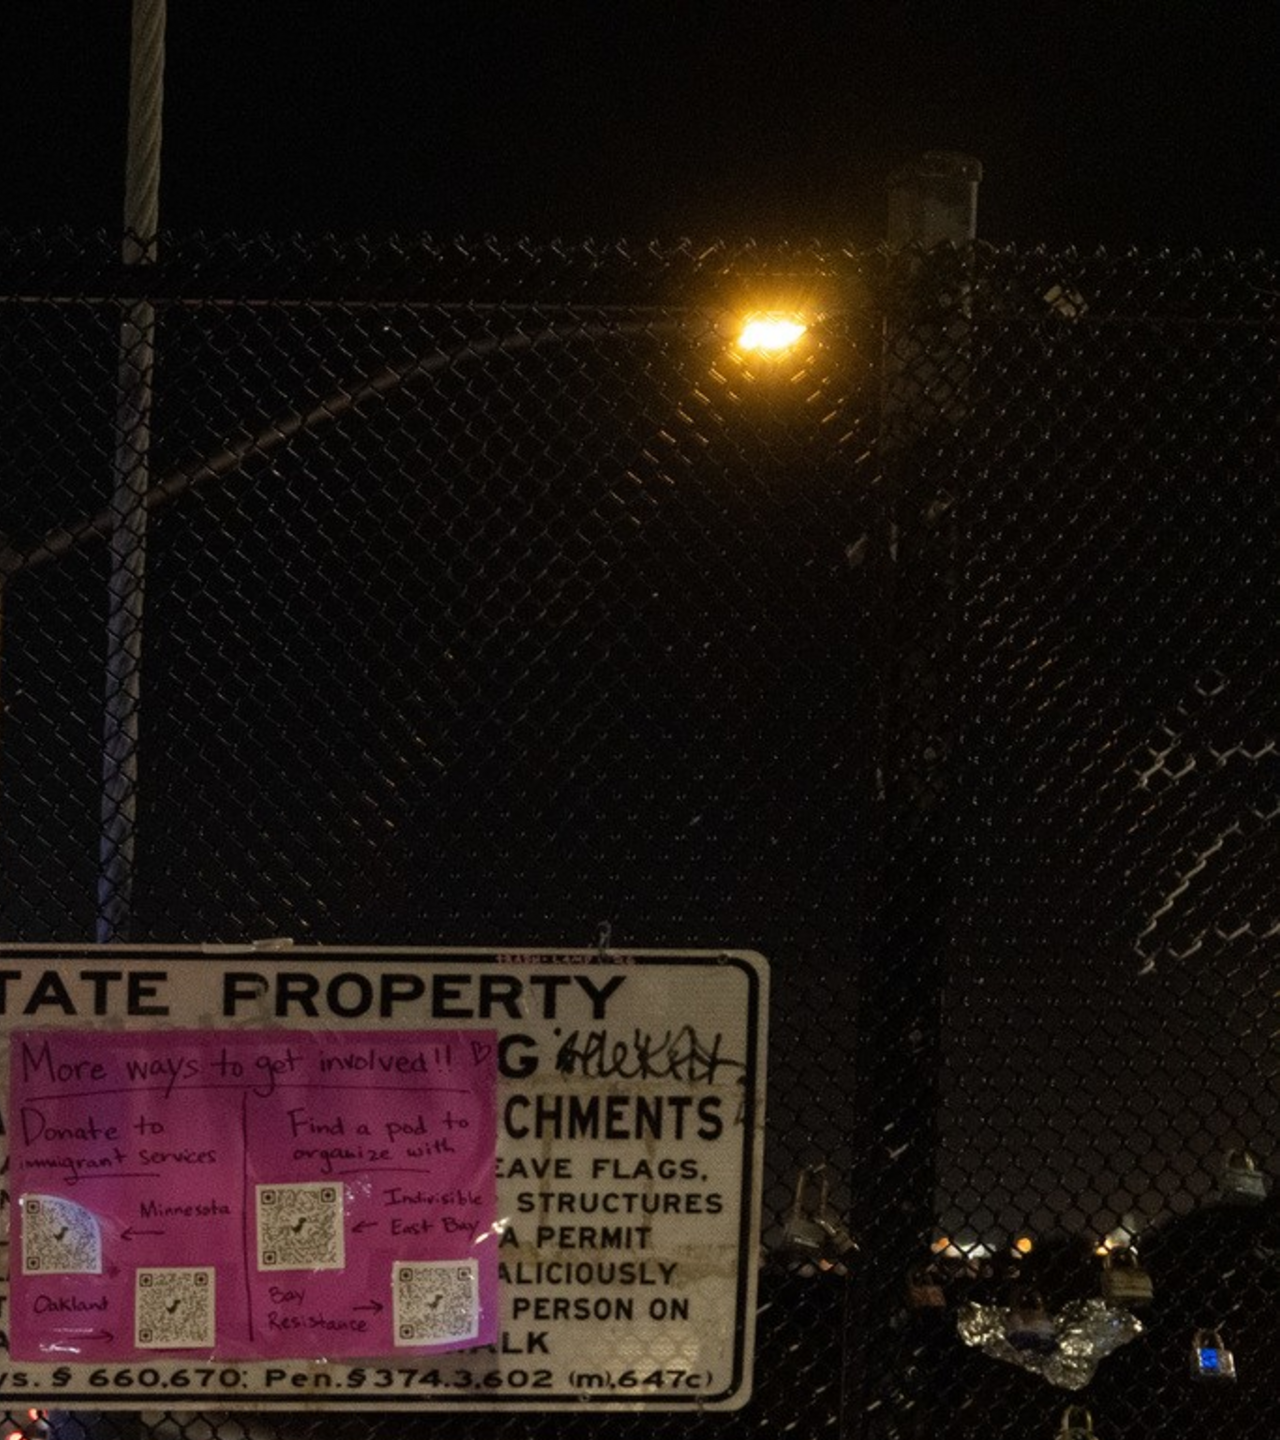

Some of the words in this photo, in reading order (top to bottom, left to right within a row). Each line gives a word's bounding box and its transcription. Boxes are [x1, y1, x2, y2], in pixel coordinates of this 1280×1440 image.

[223, 971, 626, 1019] PROPERTY
[22, 1043, 106, 1082] More
[127, 1057, 199, 1097] ways
[211, 1048, 242, 1077] to
[256, 1050, 295, 1097] get
[22, 1107, 117, 1145] Donate
[134, 1116, 163, 1134] to
[290, 1109, 345, 1137] Find
[357, 1125, 371, 1135] a
[387, 1118, 427, 1146] pod
[443, 1111, 470, 1129] to
[18, 1149, 127, 1181] immigrant
[140, 1149, 216, 1166] services
[293, 1145, 390, 1174] organize
[407, 1139, 455, 1156] with
[385, 1188, 483, 1207] Indivisible
[518, 1193, 722, 1214] STRUCTURES
[140, 1202, 231, 1217] Minnesota
[391, 1219, 430, 1236] East
[443, 1219, 479, 1240] Bay
[537, 1227, 651, 1249] PERMIT
[34, 1296, 107, 1314] Oakland
[268, 1287, 304, 1307] Bay
[514, 1298, 634, 1320] PERSON
[650, 1299, 689, 1320] ON
[268, 1312, 368, 1333] Resistance
